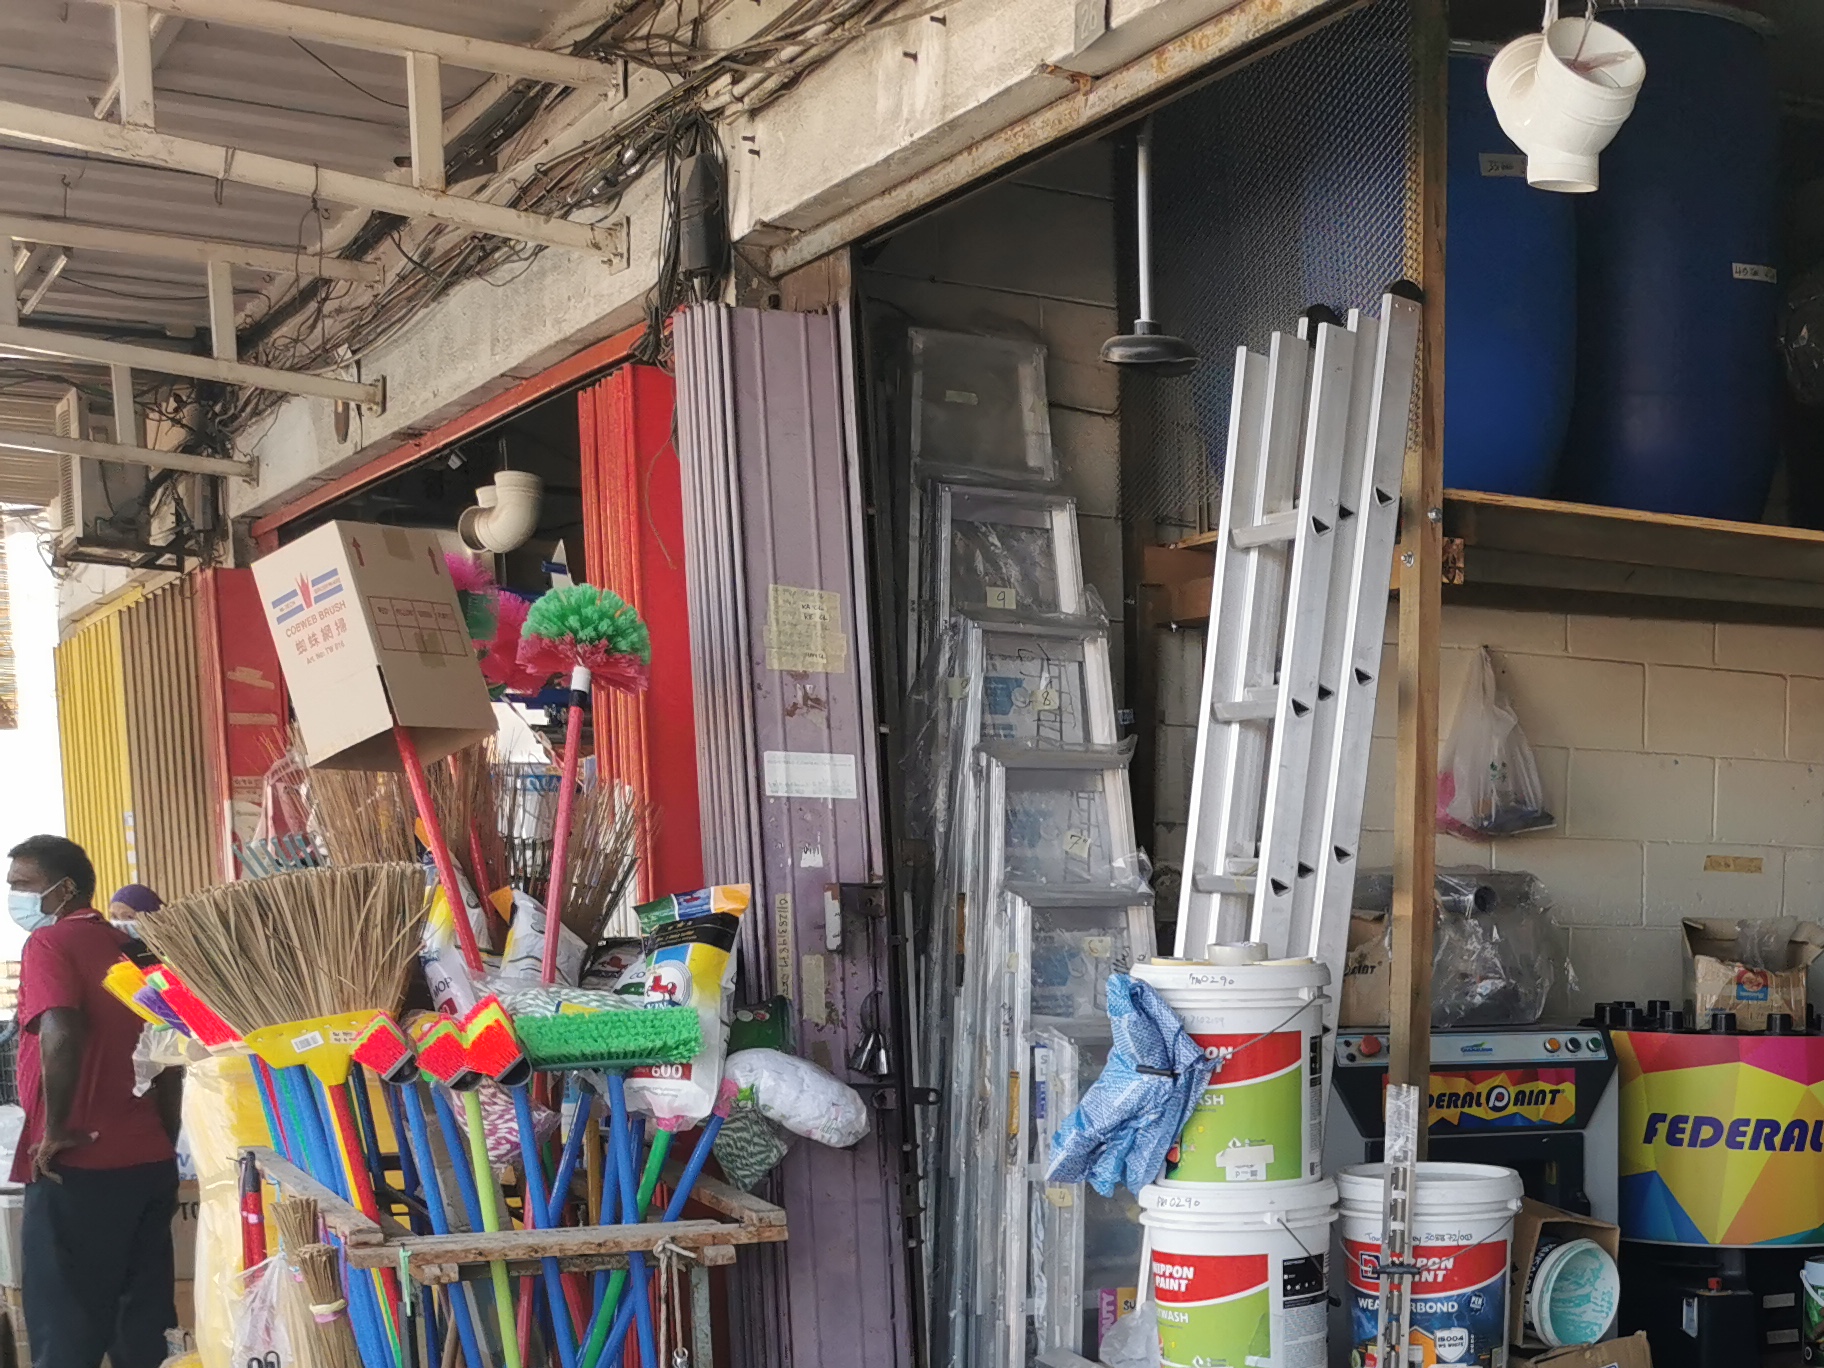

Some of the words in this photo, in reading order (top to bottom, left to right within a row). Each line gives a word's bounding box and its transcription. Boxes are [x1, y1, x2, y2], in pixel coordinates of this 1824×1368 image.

[996, 590, 1006, 608] 9
[286, 611, 318, 638] COBWEB
[319, 600, 347, 621] BRUSH
[432, 976, 453, 998] MOP
[651, 1064, 683, 1079] 600
[1643, 1111, 1824, 1153] FEDERAL
[1155, 1276, 1189, 1292] PAINT
